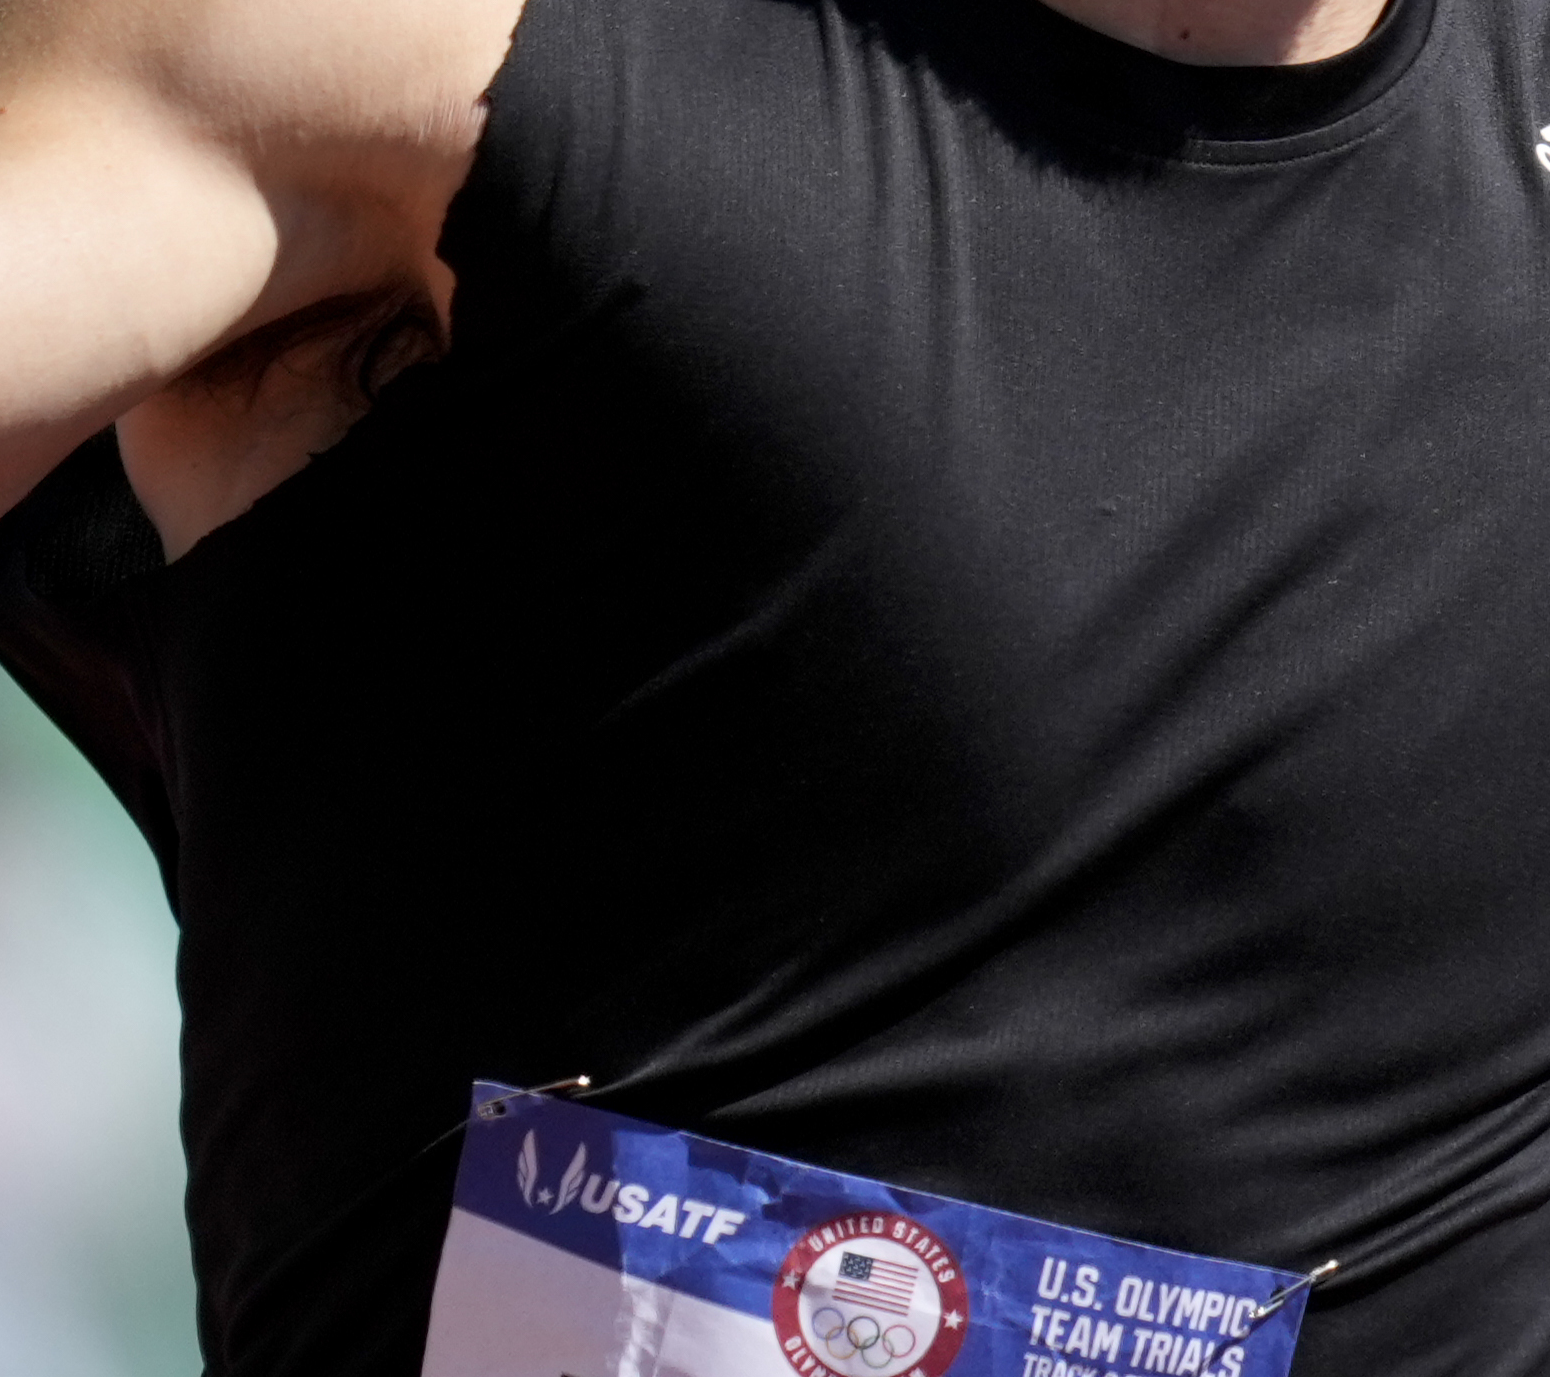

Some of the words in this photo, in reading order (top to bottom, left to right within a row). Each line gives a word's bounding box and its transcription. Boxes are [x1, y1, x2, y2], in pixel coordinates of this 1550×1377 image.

[580, 1174, 746, 1245] USATF
[808, 1217, 884, 1252] UNITED
[892, 1220, 956, 1283] STATES
[1037, 1257, 1102, 1311] U.S.
[1115, 1275, 1257, 1338] OLYMPIC
[1029, 1304, 1124, 1364] TEAM
